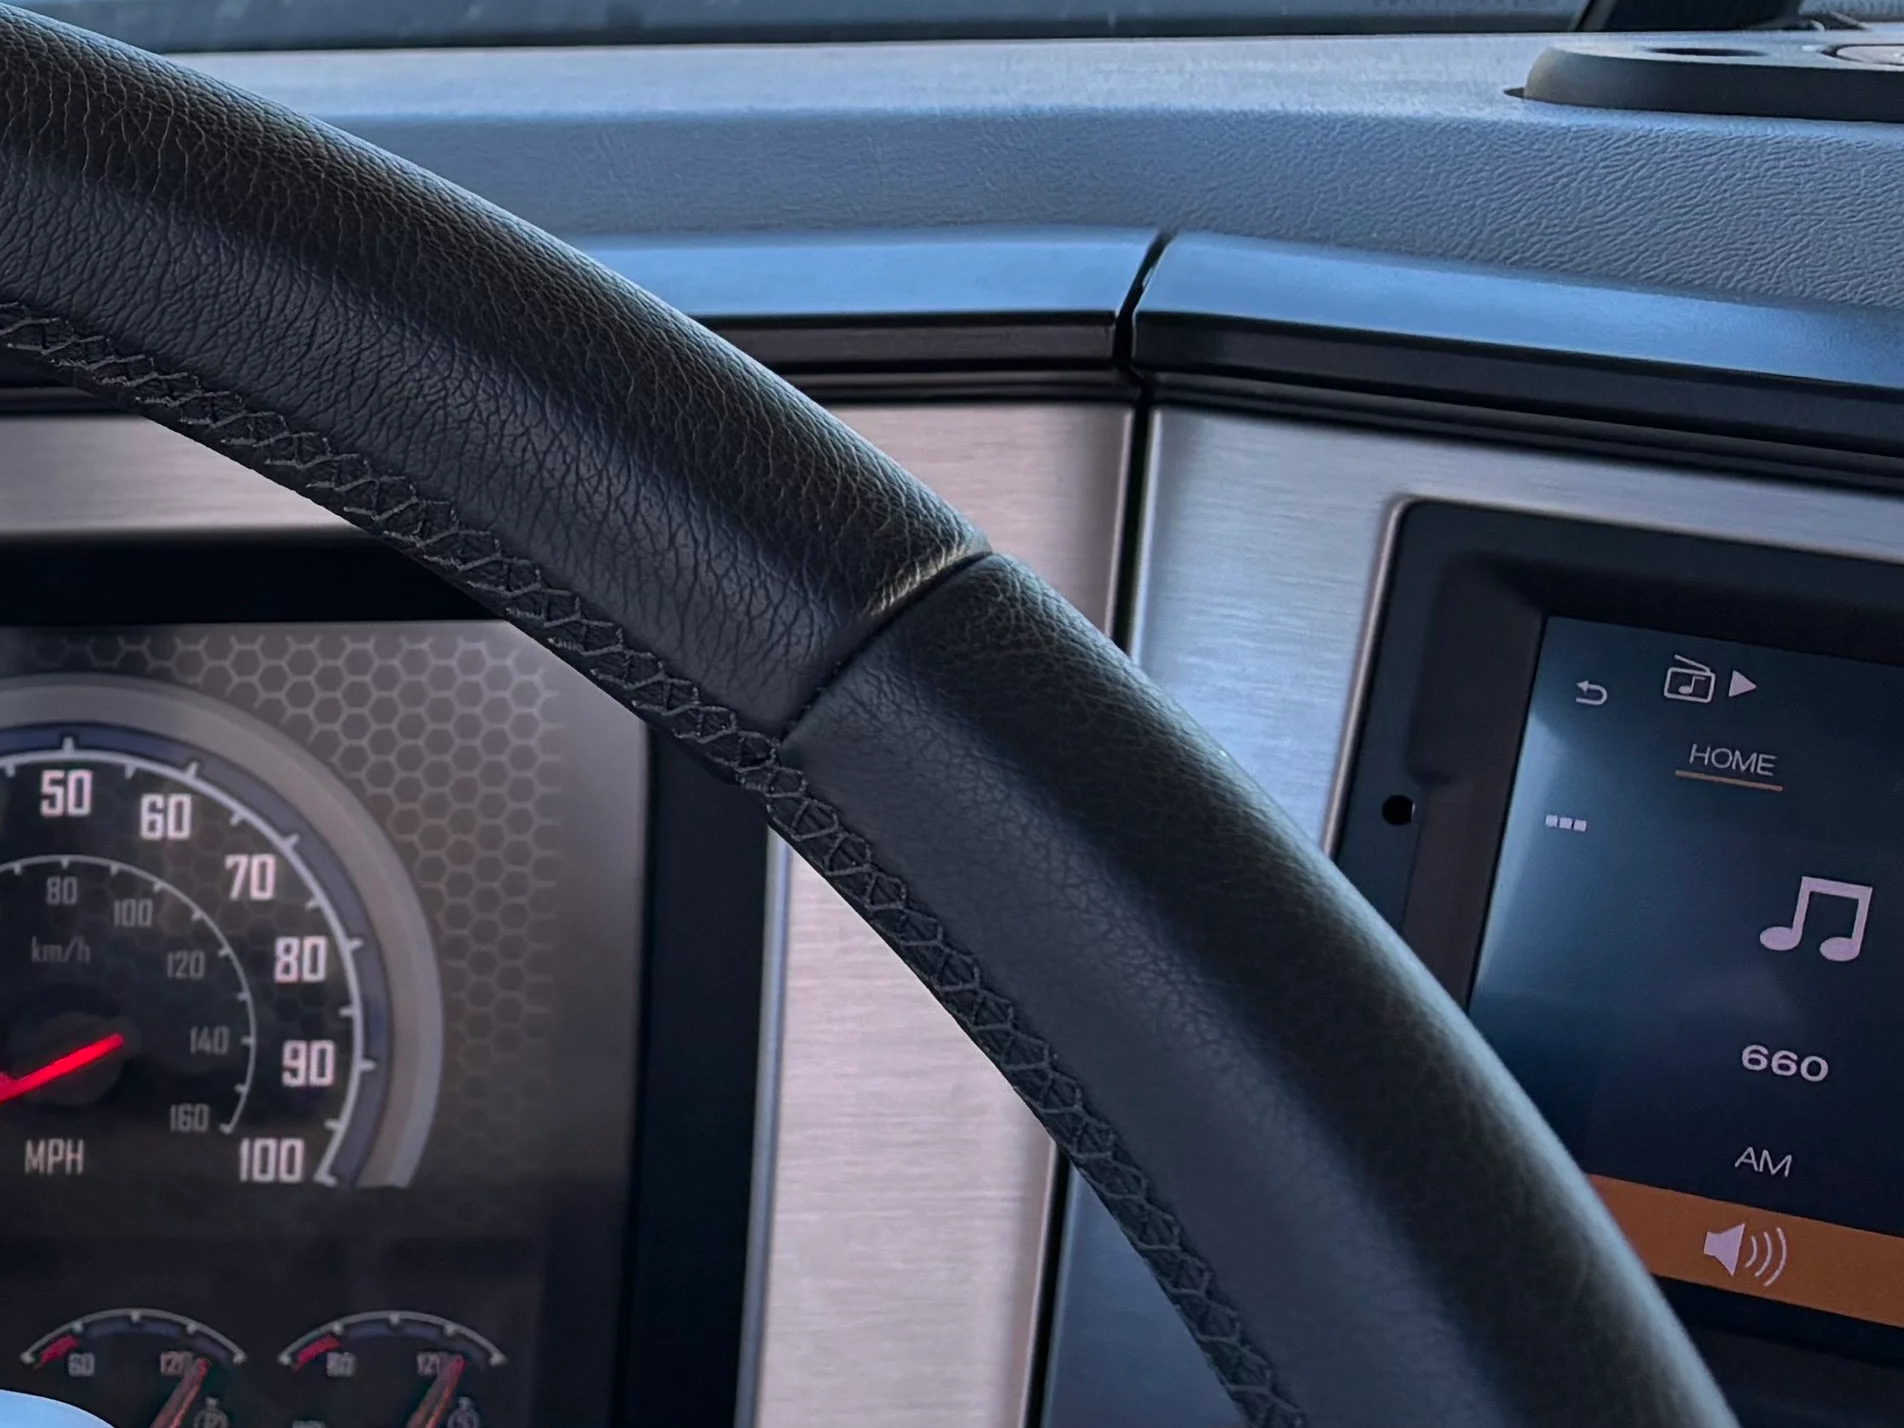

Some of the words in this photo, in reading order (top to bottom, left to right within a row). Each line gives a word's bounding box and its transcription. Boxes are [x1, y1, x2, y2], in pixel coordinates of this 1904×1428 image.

[1689, 743, 1777, 776] HOME
[41, 769, 92, 815] 50
[141, 794, 192, 839] 60
[46, 876, 78, 905] 80
[226, 854, 276, 900] 70
[114, 898, 154, 927] 100
[31, 935, 91, 964] km/h
[167, 950, 206, 979] 120
[275, 936, 327, 982] 80
[190, 1025, 230, 1055] 140
[283, 1040, 334, 1086] 90
[1742, 1044, 1829, 1083] 660
[170, 1103, 210, 1133] 160
[25, 1138, 84, 1173] MPH
[240, 1138, 304, 1182] 100
[1734, 1146, 1792, 1178] AM
